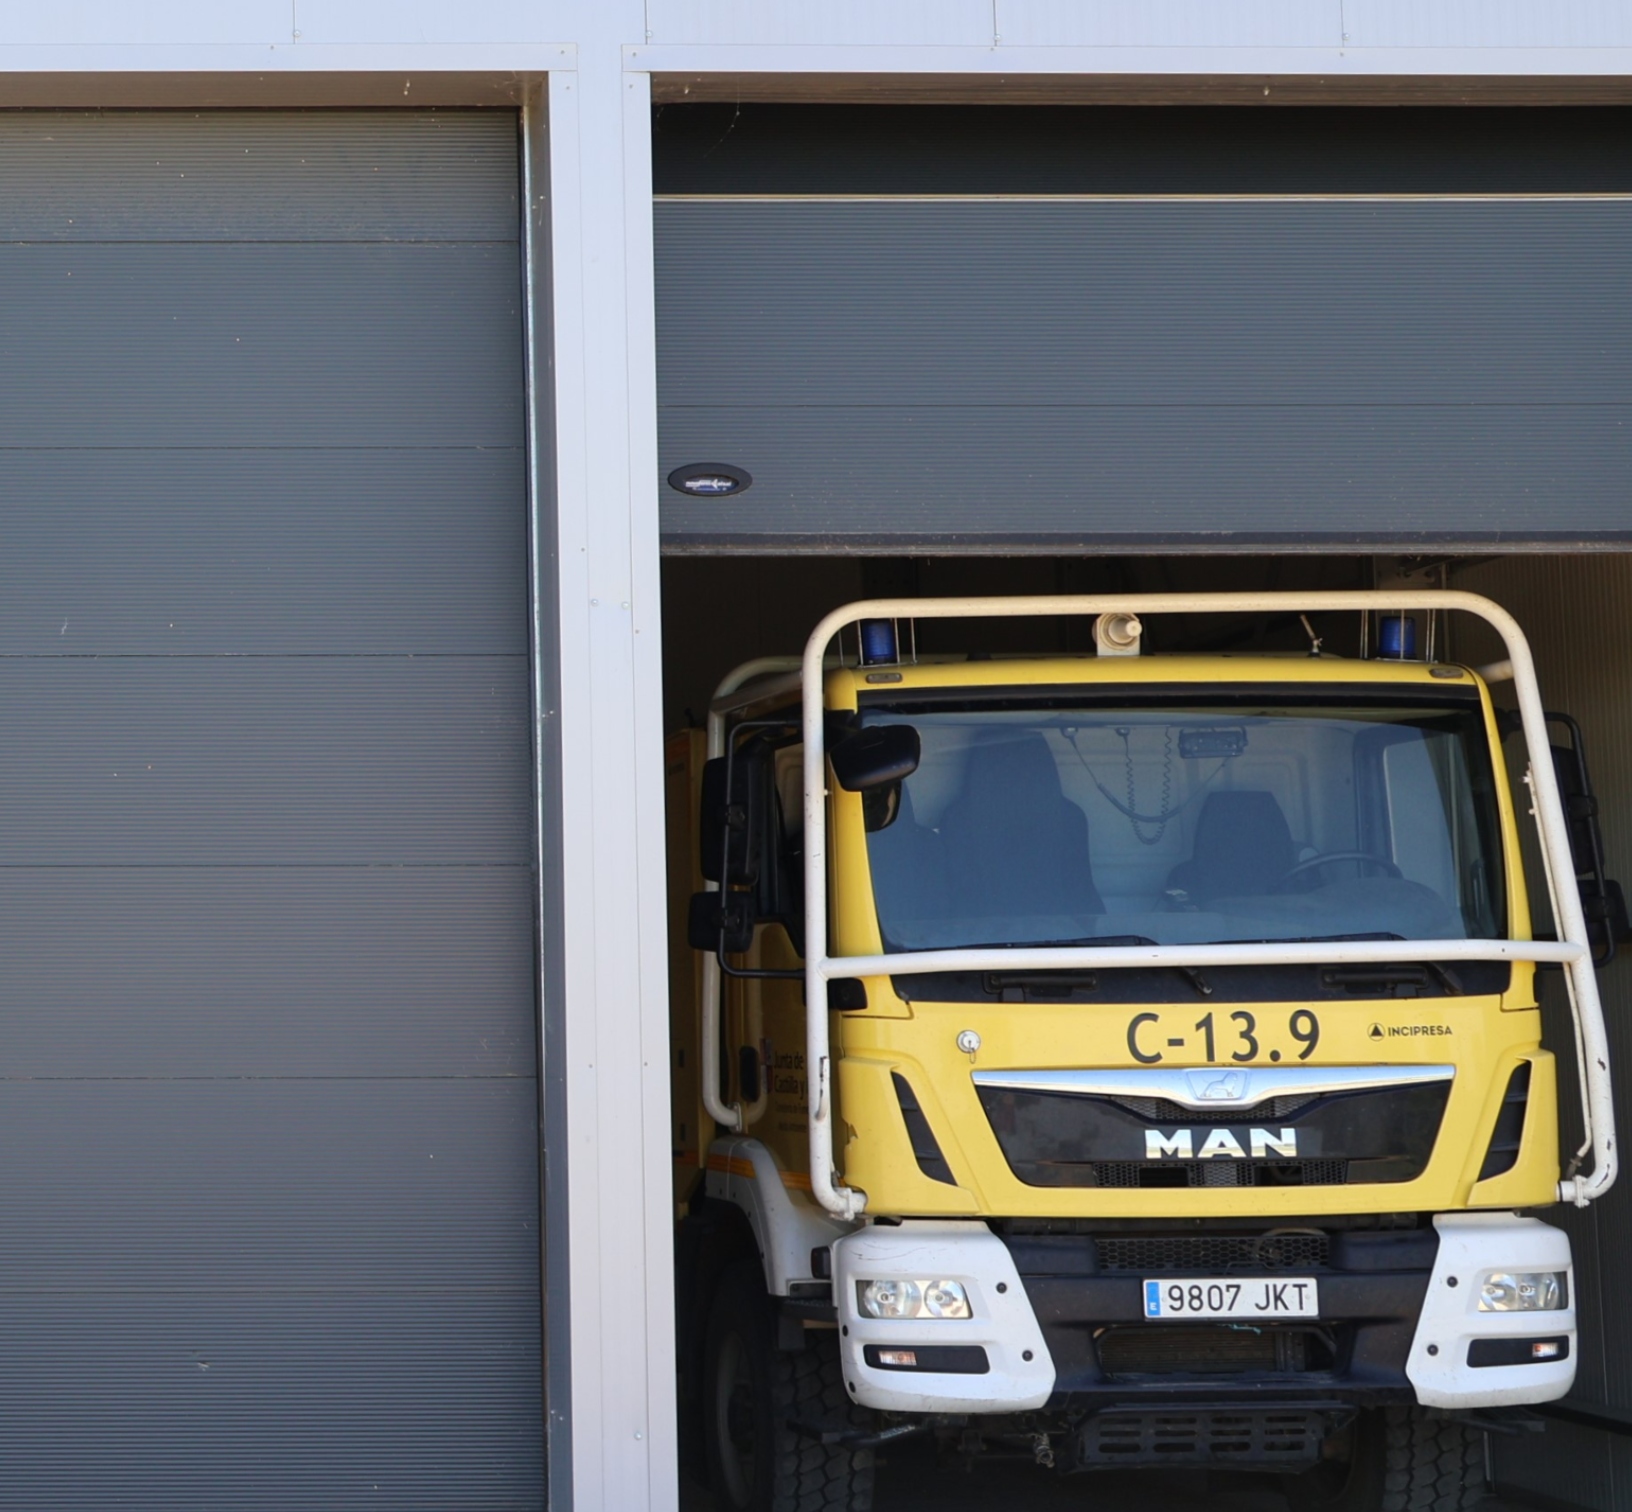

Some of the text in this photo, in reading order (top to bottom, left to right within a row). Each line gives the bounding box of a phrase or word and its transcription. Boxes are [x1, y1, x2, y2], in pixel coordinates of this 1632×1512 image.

[1126, 1009, 1320, 1064] C-13.9
[1387, 1025, 1453, 1037] INCIPRESA
[1144, 1127, 1297, 1159] MAN
[1168, 1283, 1308, 1312] 9807 JKT
